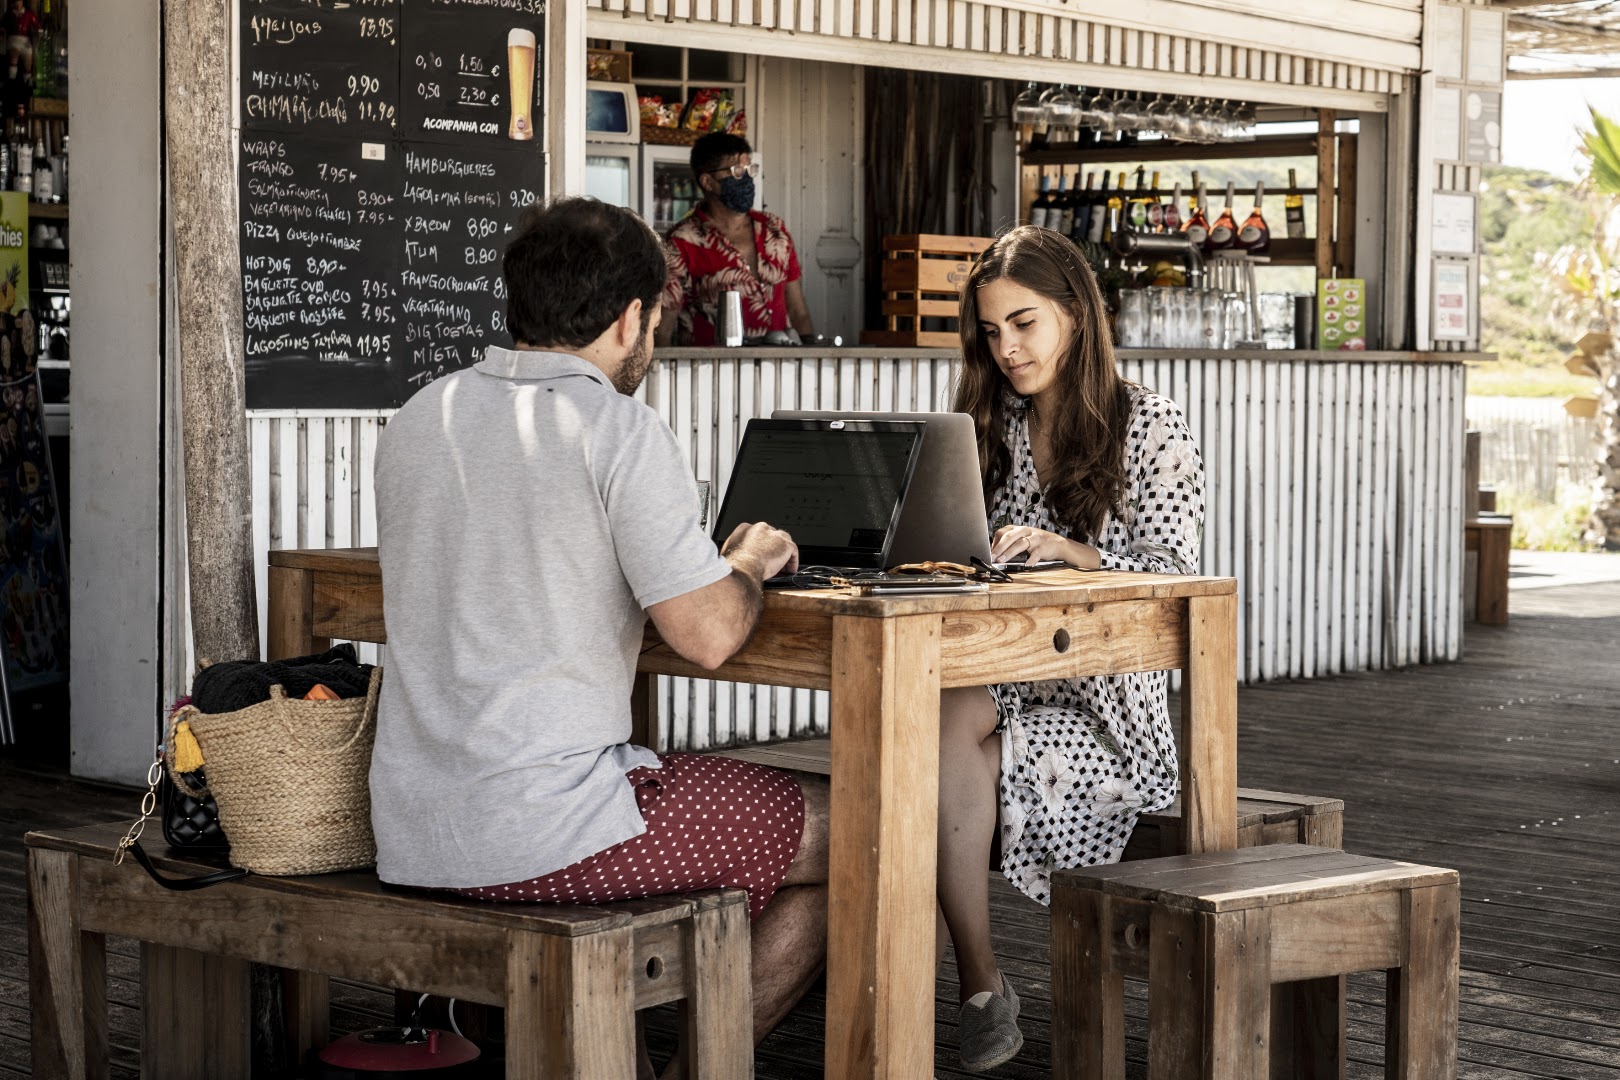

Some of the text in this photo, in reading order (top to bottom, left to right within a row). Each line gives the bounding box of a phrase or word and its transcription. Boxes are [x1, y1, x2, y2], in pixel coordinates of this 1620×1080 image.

[423, 117, 499, 134] ACOMPANHA COM
[243, 140, 286, 159] WRAPS
[247, 160, 294, 177] FRANGO
[405, 151, 496, 178] HAMBURGUERES
[405, 239, 438, 265] ATUM
[246, 256, 266, 270] HOT
[267, 257, 291, 275] DOG
[401, 270, 446, 290] FRANGO
[405, 322, 431, 342] BIG
